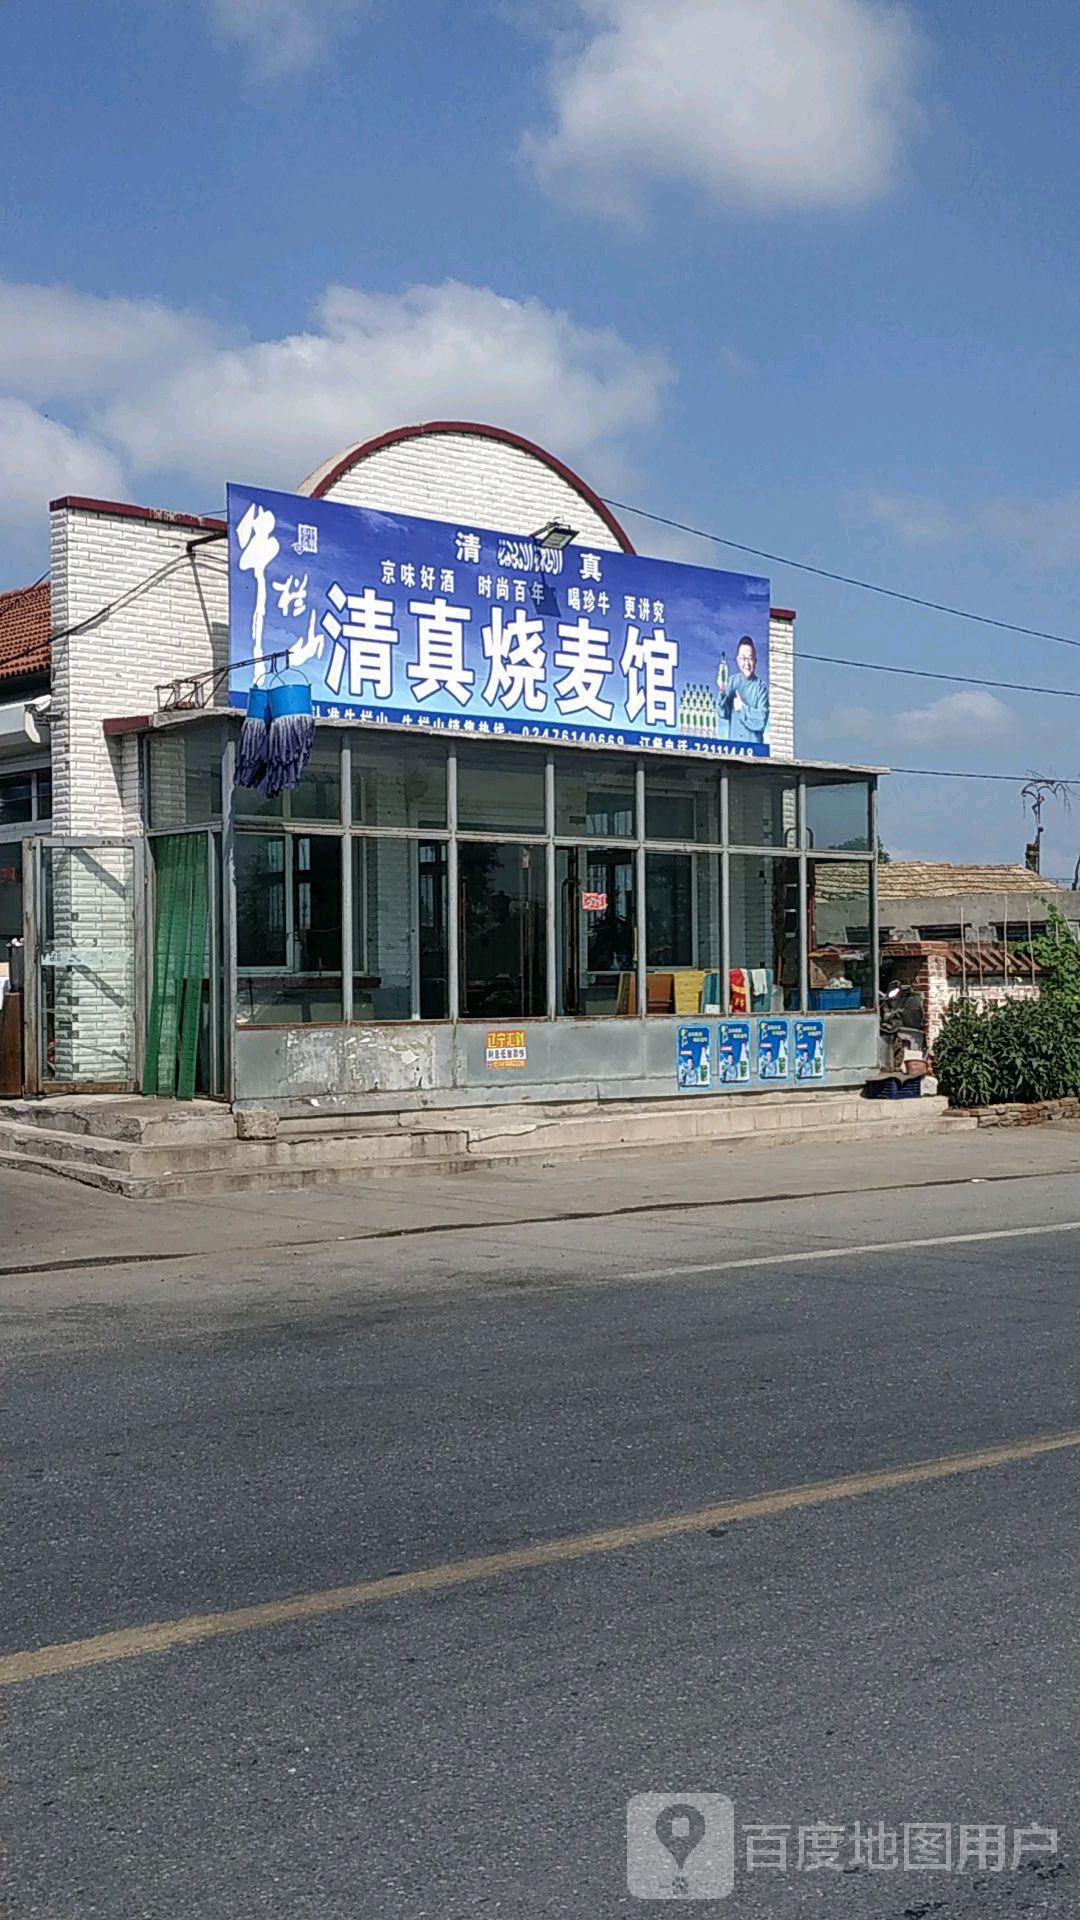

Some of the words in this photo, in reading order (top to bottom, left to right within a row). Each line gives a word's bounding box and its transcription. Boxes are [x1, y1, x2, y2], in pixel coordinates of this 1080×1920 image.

[455, 532, 481, 563] 清
[580, 553, 603, 582] 真
[381, 559, 455, 593] 京味好酒
[478, 575, 545, 605] 时尚百年
[567, 587, 610, 616] 喝珍牛
[624, 595, 665, 623] 更讲究
[321, 582, 678, 727] 清真烧麦馆
